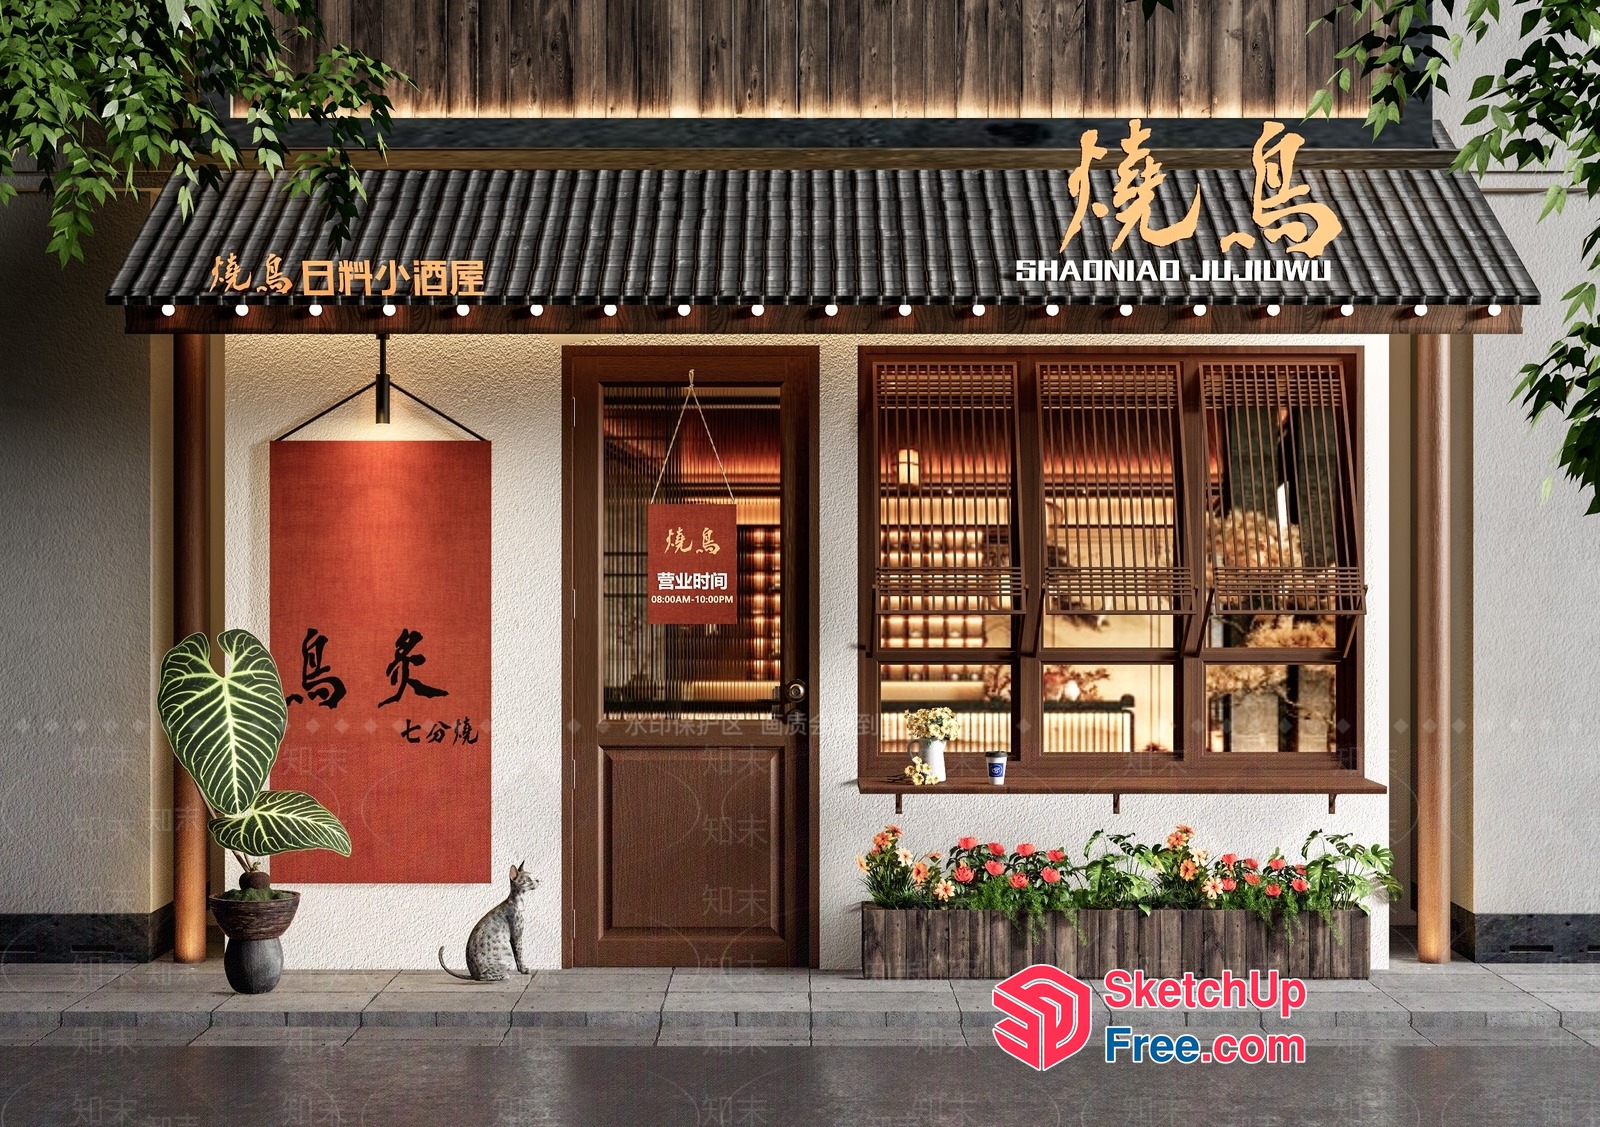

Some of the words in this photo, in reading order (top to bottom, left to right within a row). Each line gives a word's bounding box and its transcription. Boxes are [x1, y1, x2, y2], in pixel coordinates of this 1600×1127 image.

[1016, 259, 1180, 282] SHAONIAO
[1190, 259, 1331, 282] JUJIUWU
[657, 571, 728, 591] 营业时间
